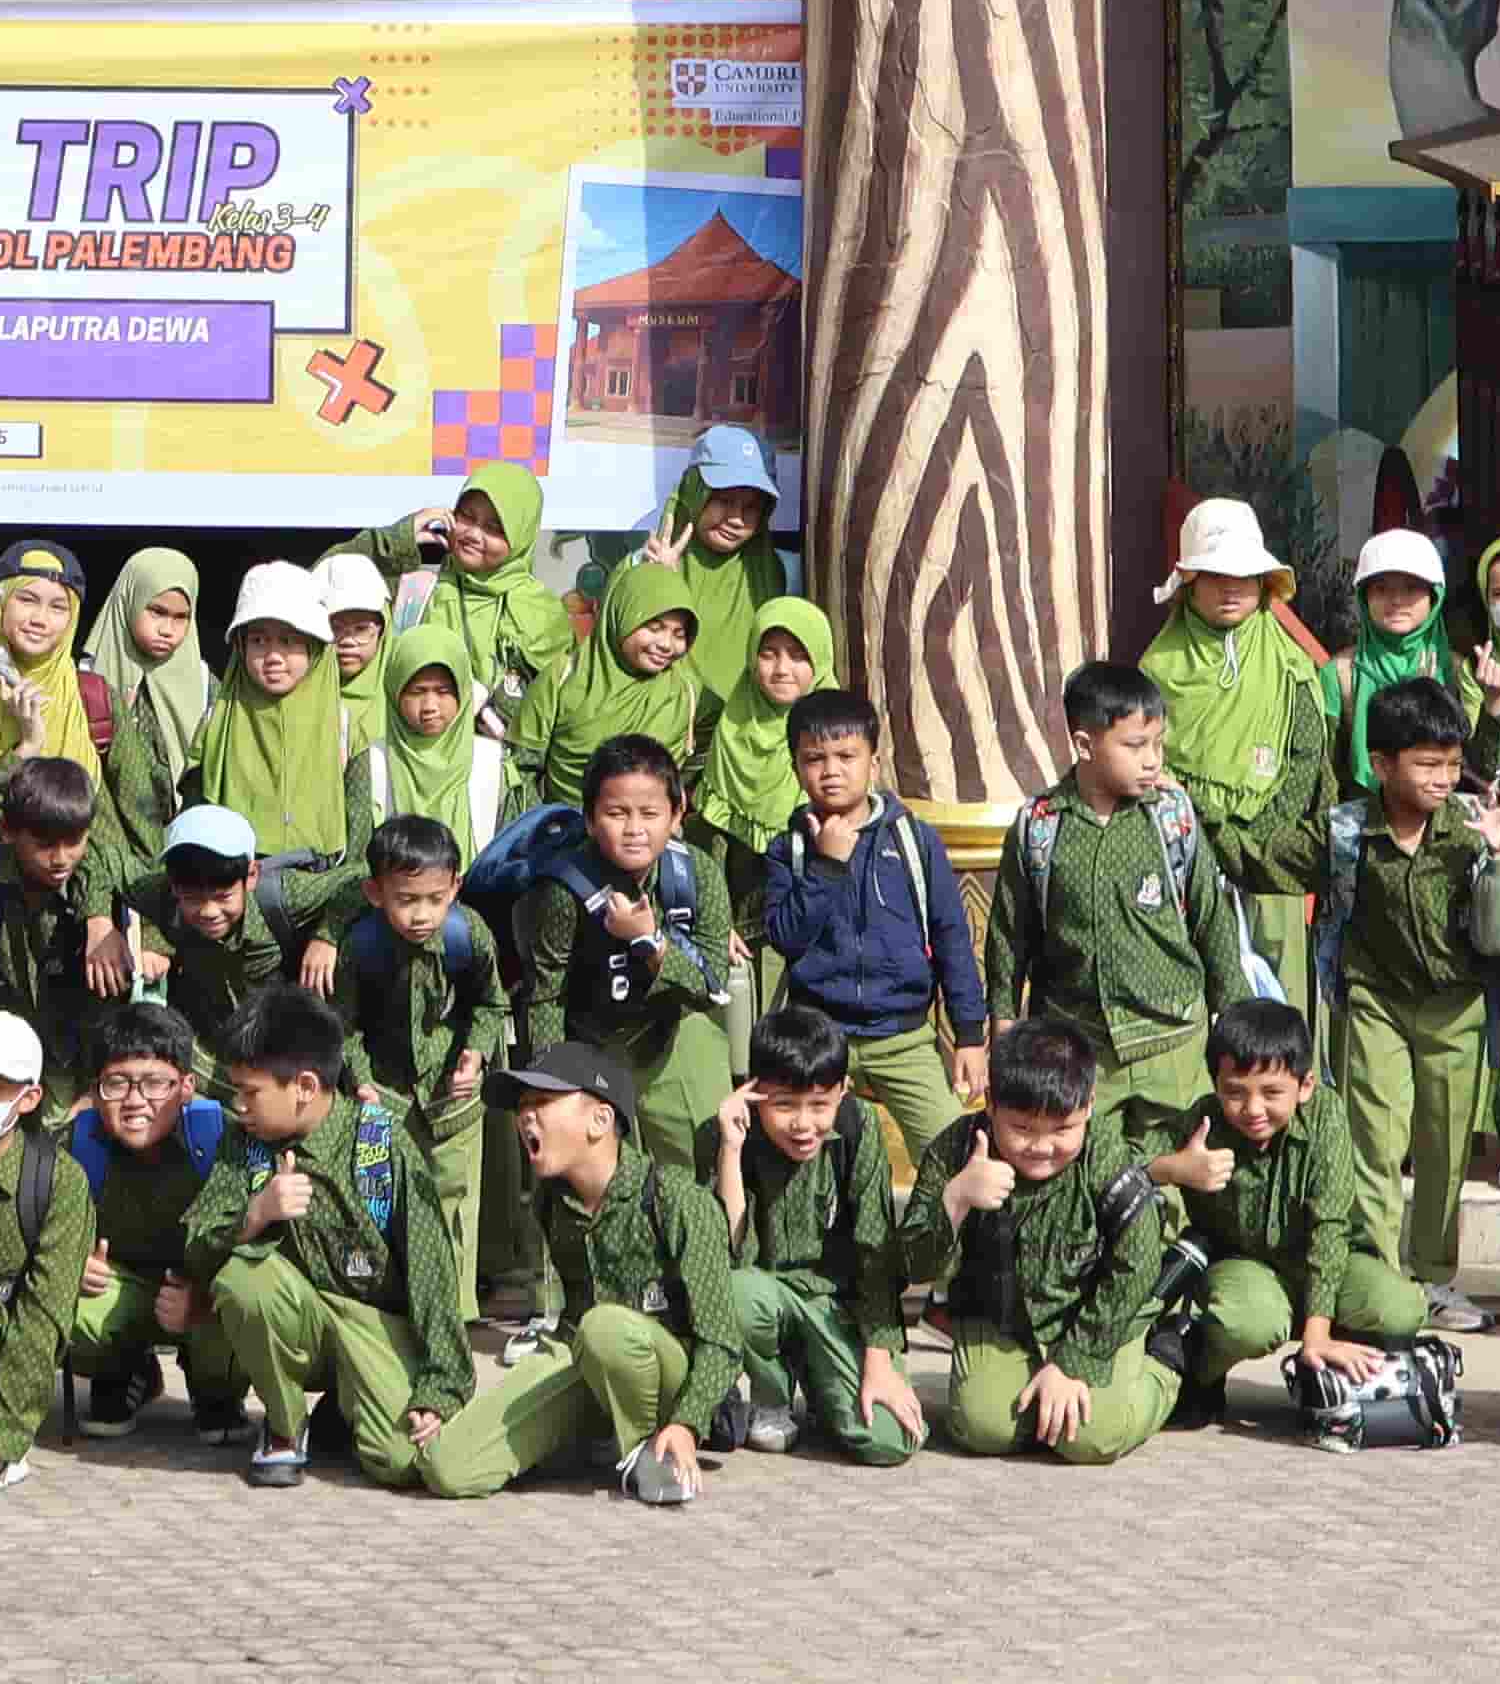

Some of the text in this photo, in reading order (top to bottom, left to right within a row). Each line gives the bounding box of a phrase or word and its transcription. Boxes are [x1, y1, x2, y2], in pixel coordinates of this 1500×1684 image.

[16, 119, 281, 222] TRIP
[206, 199, 270, 231] Kelas
[43, 230, 297, 273] PALEMBANG
[126, 316, 211, 344] DEWA
